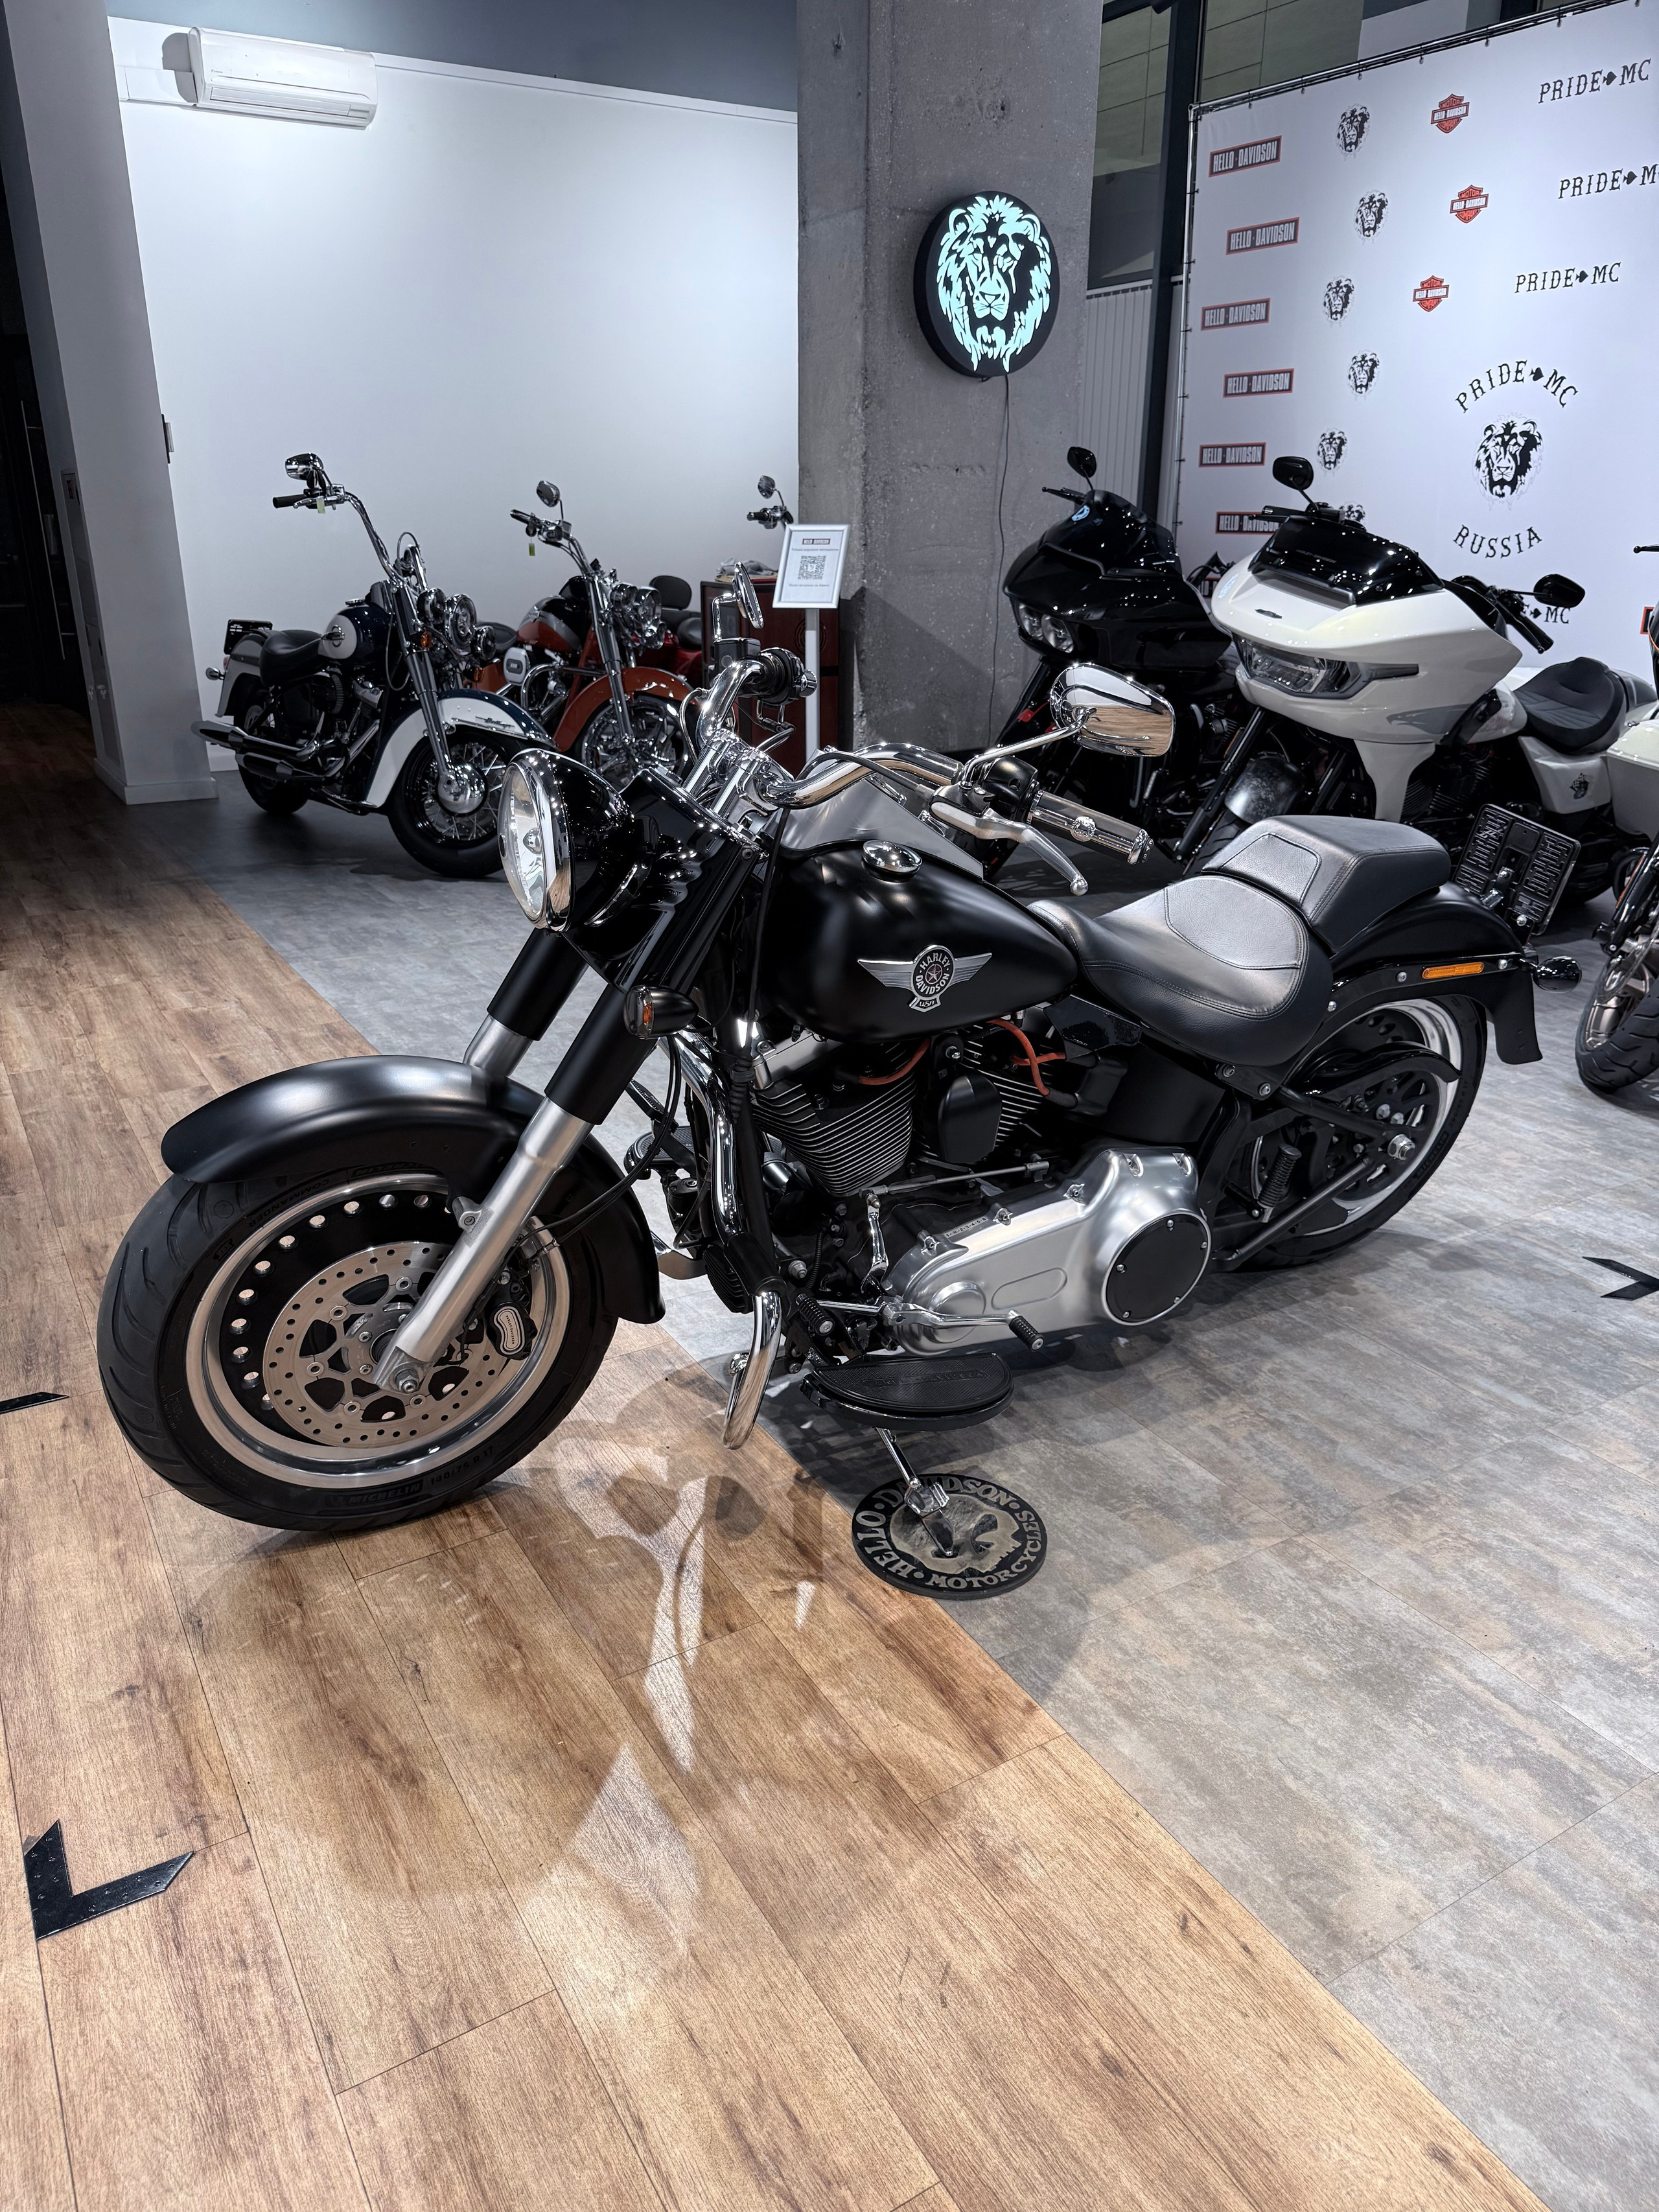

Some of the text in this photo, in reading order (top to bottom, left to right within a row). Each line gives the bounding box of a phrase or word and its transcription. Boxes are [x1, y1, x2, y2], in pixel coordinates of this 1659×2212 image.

[1538, 58, 1651, 104] PRIDE MC
[1212, 141, 1277, 172] HELLO DAVIDSON
[1558, 163, 1659, 199] PRIDE M
[1230, 222, 1295, 250] HELLO DAVIDSON
[1514, 262, 1621, 293] PRIDE MC
[1204, 302, 1267, 327] HELLO DAVIDSON
[1227, 373, 1290, 394] HELLO DAVIDSON
[1455, 360, 1579, 413] PRIDE MC
[1202, 446, 1262, 464] HELLO DAVIDSON
[1219, 515, 1240, 531] HELLO
[1453, 524, 1542, 559] RUSSIA
[920, 952, 951, 970] HARLEY
[916, 973, 950, 995] DAVIDSON
[248, 1178, 329, 1228] COMMANDER
[348, 1445, 494, 1505] MICHELIN 140/75 R 17
[855, 1510, 916, 1578] HELLO
[925, 1510, 1041, 1589] MOTORCYCLES
